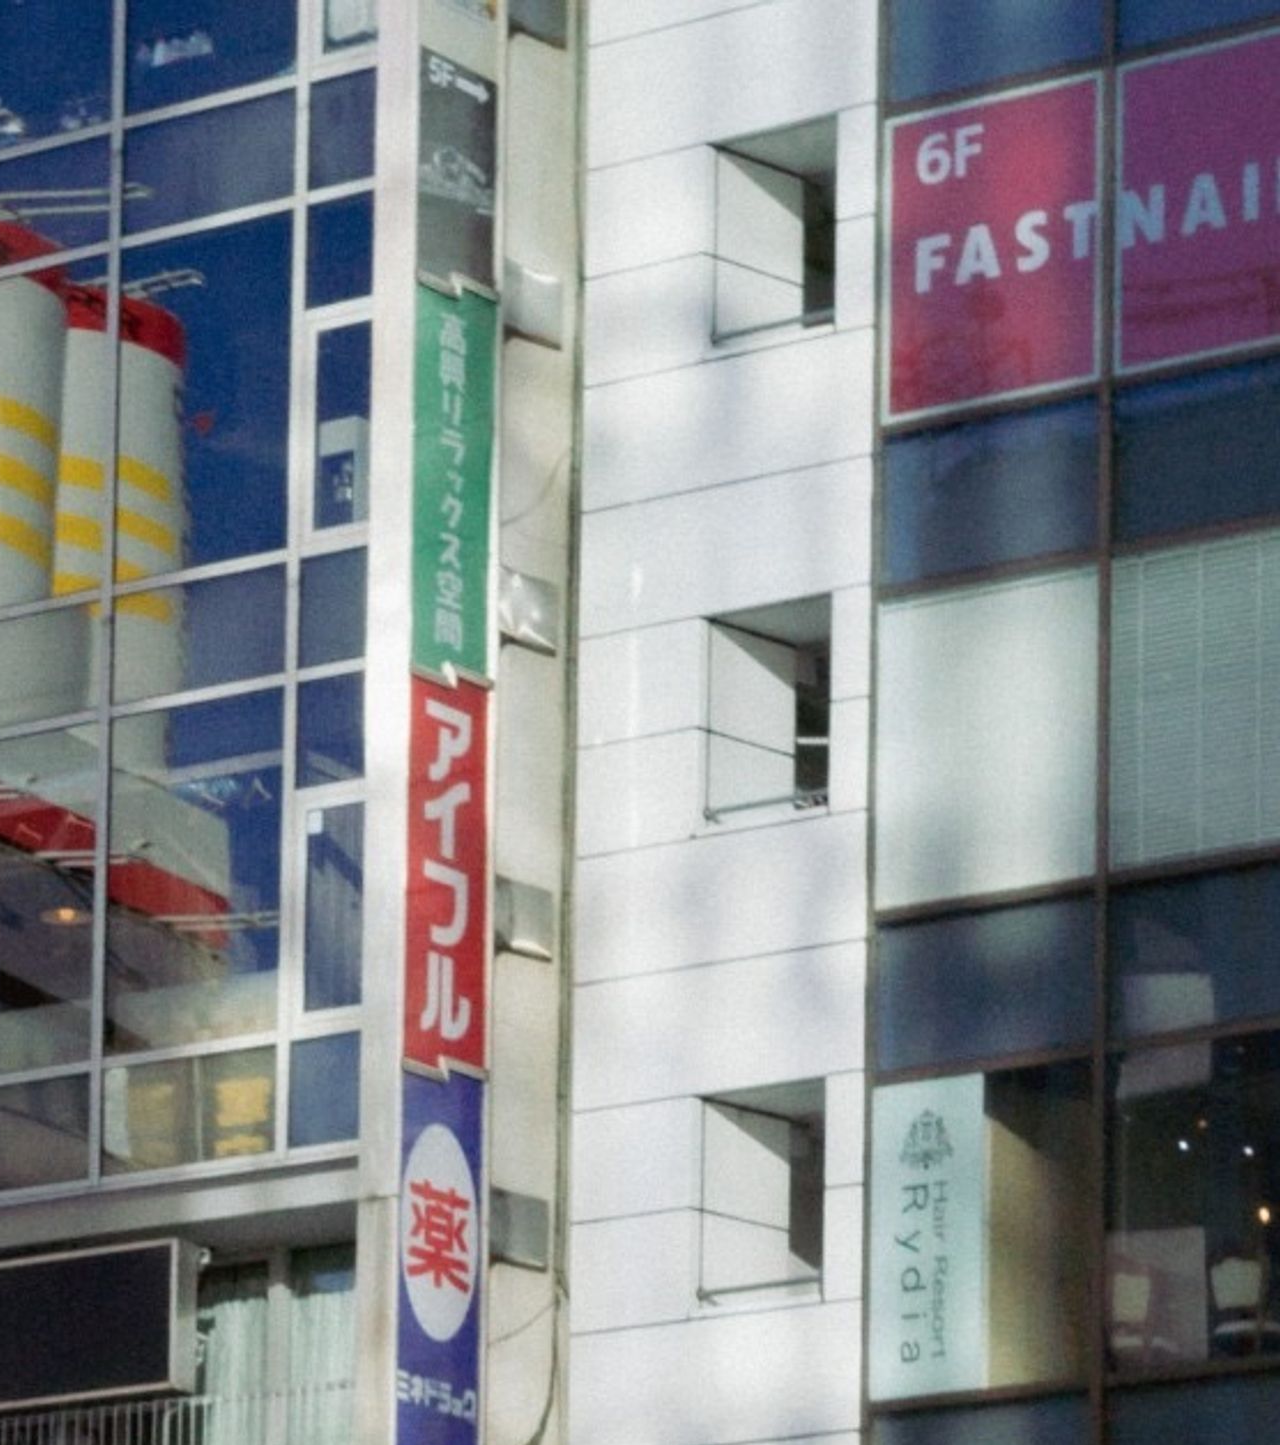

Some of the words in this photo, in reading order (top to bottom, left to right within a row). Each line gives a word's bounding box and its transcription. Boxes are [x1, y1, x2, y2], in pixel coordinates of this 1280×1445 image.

[916, 123, 985, 186] 6F
[914, 155, 1280, 294] FASTNAI
[419, 698, 473, 1042] アイフル
[405, 1177, 472, 1294] 薬
[894, 1182, 930, 1365] Rydia
